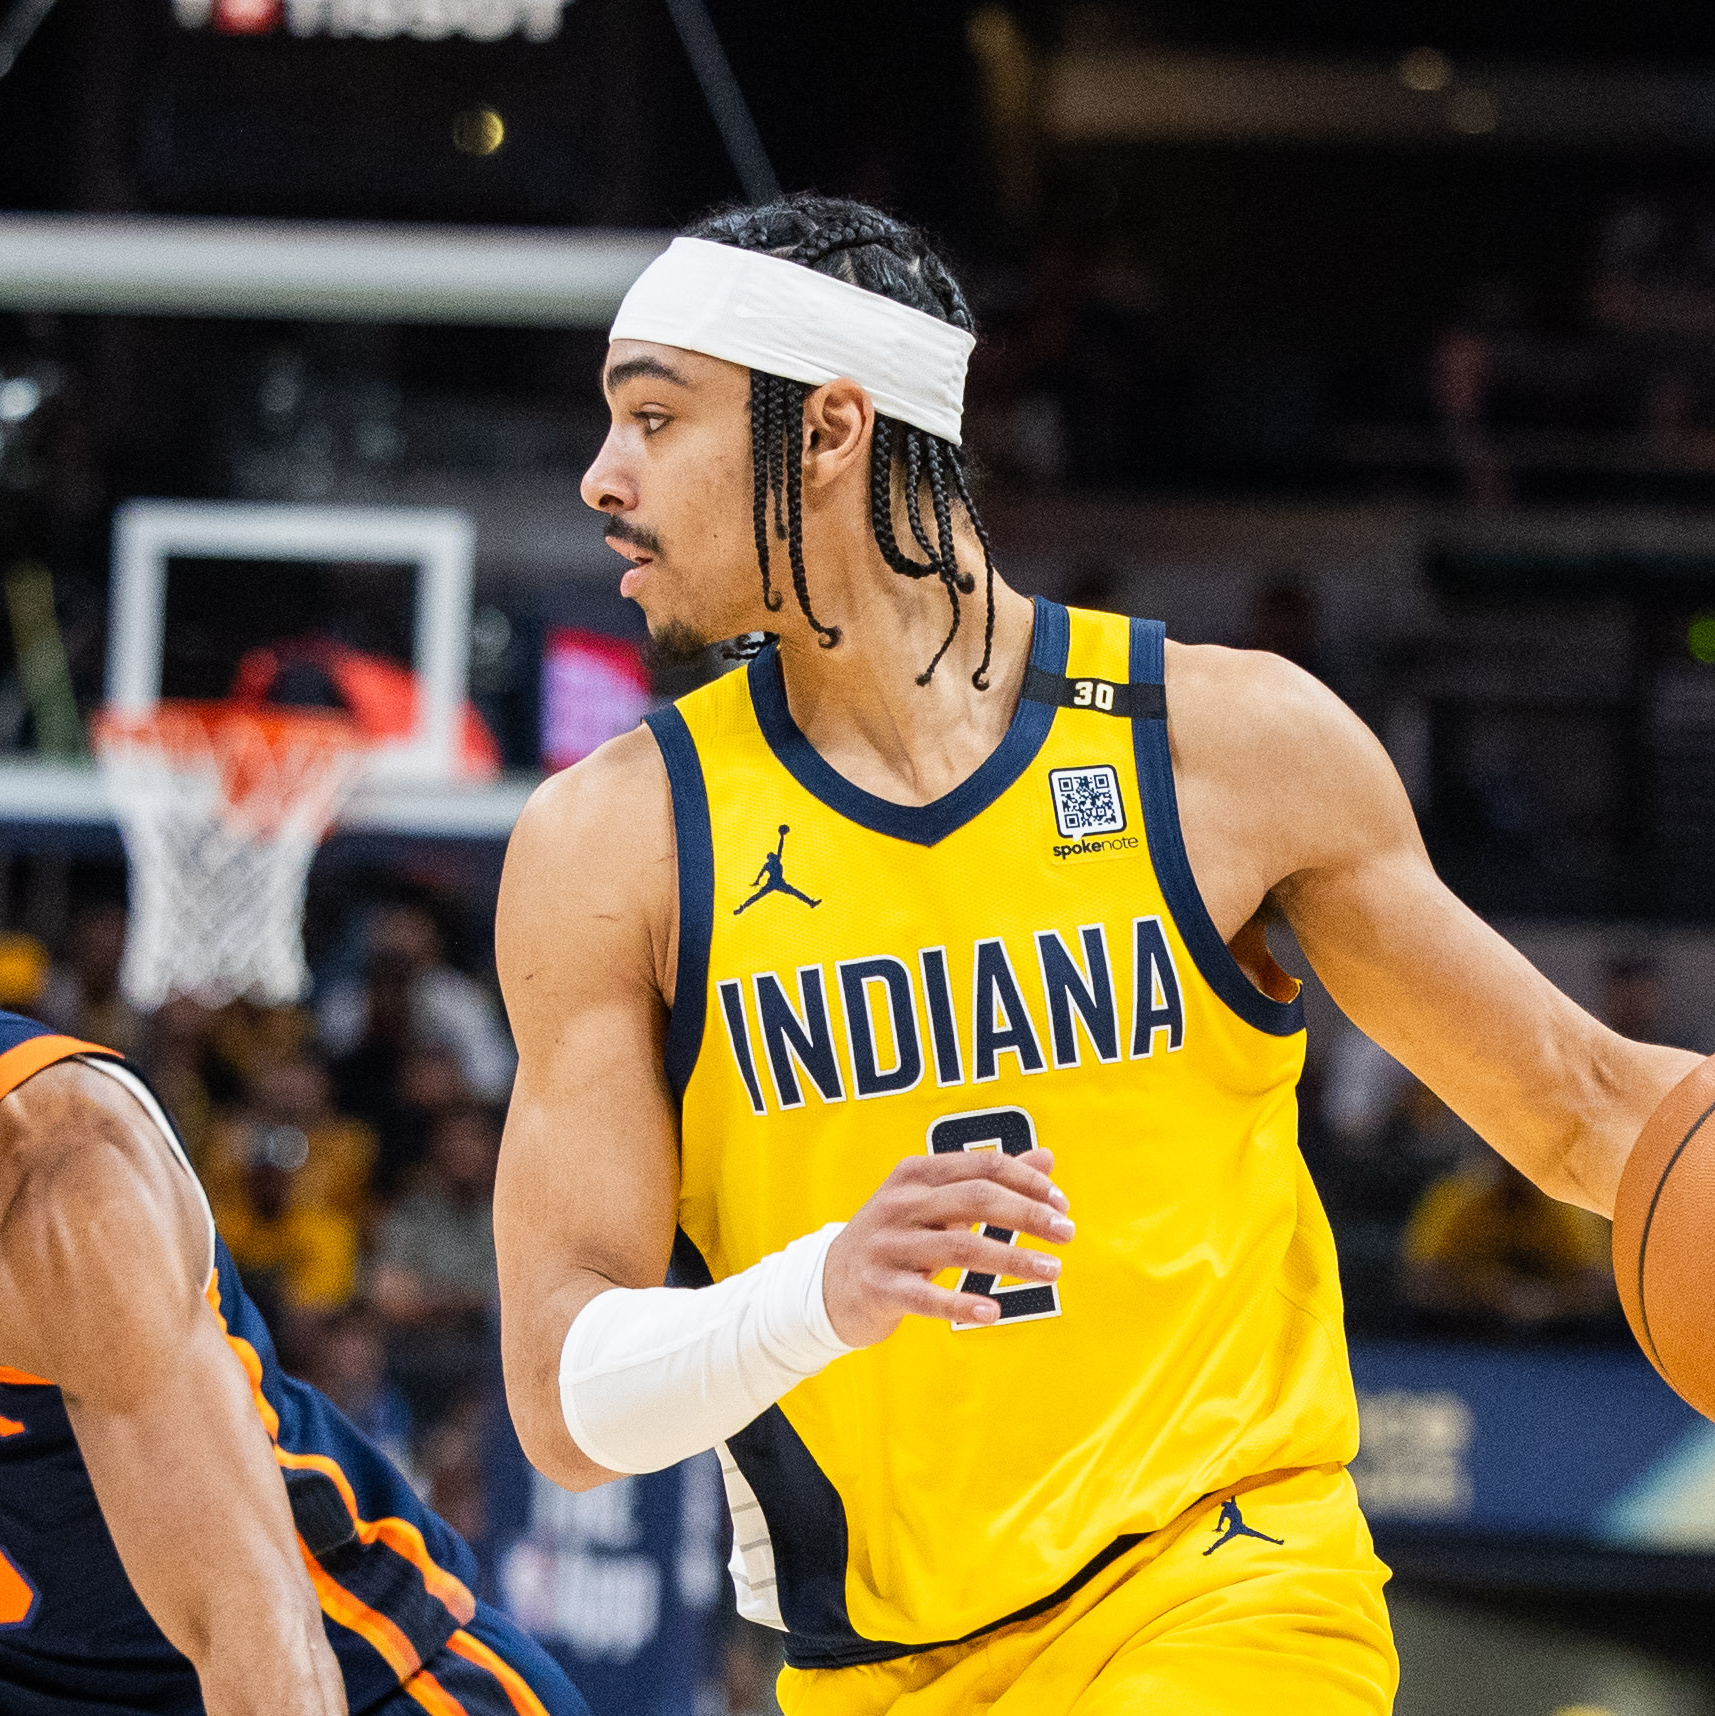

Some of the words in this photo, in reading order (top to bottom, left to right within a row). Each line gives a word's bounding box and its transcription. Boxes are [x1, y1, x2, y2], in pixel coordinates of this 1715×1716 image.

[1073, 680, 1115, 711] 30
[1052, 835, 1139, 860] spokenote
[715, 914, 1186, 1117] INDIANA
